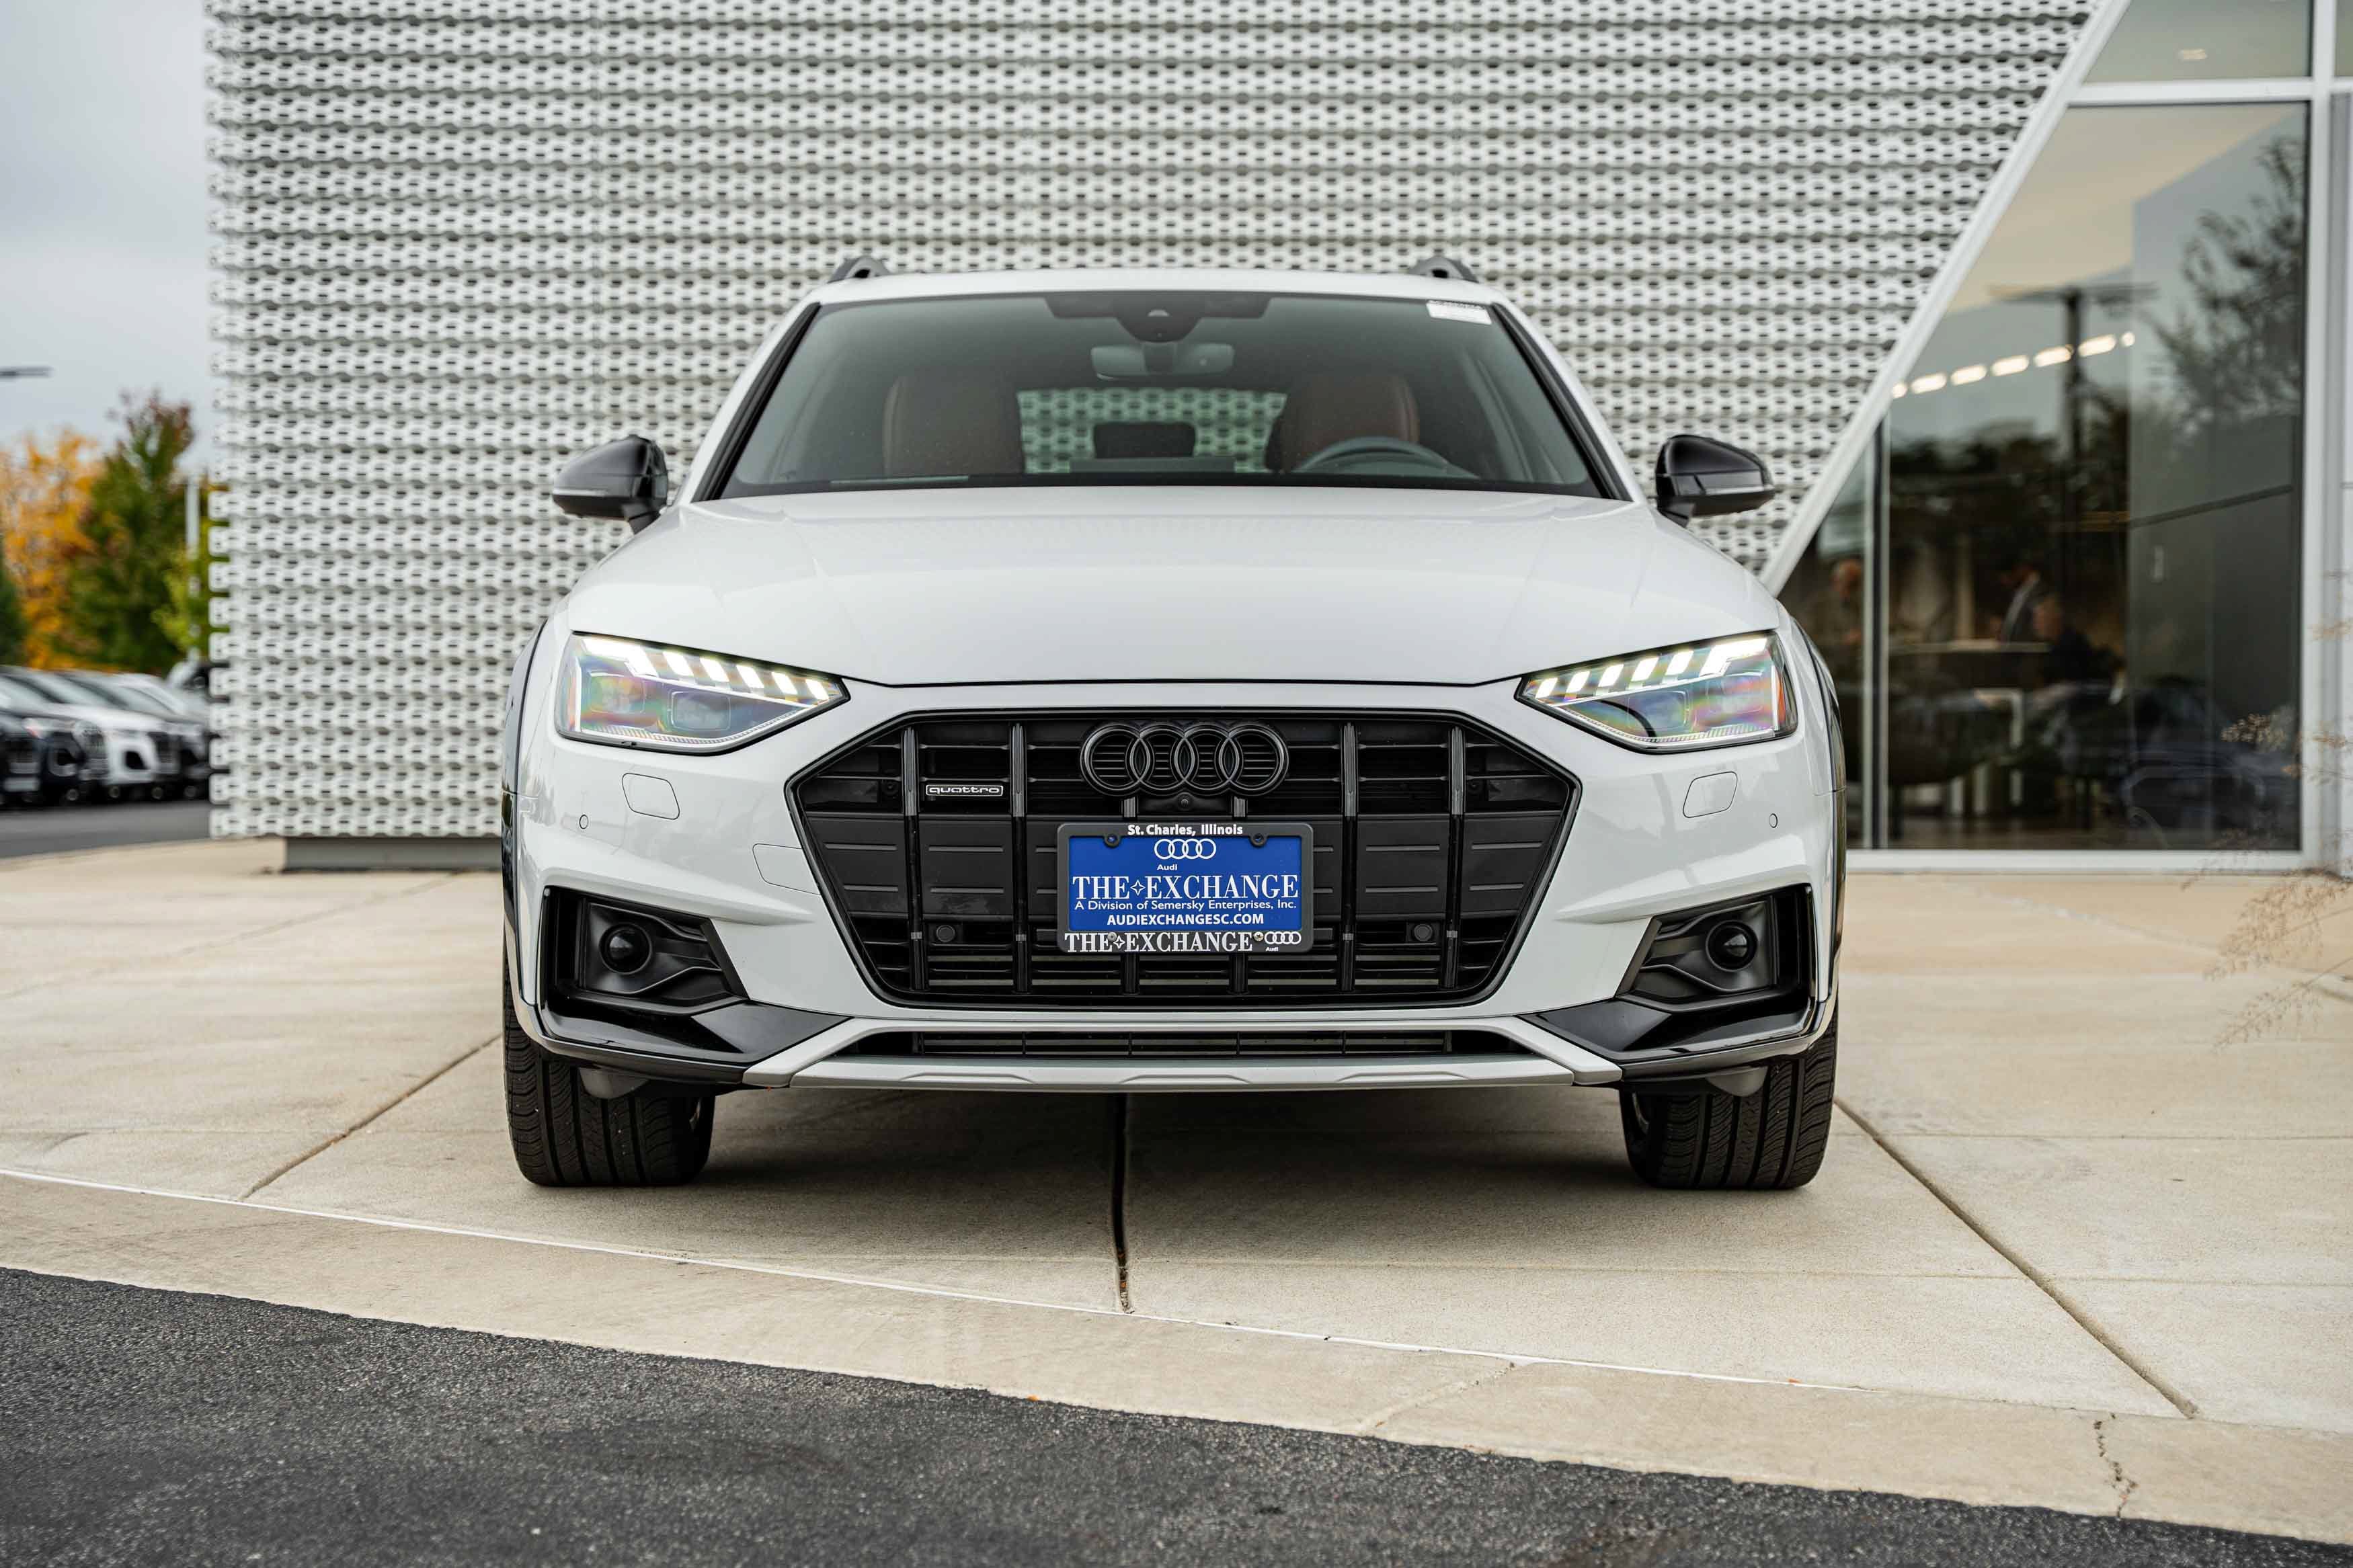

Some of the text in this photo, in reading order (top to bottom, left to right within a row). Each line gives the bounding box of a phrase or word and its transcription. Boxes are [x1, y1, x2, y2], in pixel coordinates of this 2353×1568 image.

[929, 786, 1000, 794] quattro
[1127, 824, 1243, 837] St. Charles, Illinois
[1072, 874, 1299, 900] THE EXCHANGE
[1075, 900, 1297, 912] A Division of Semersky Enterprises, Inc.
[1107, 913, 1265, 925] AUDIEXCHANGESC.COM
[1064, 932, 1253, 952] THE EXCHANGE
